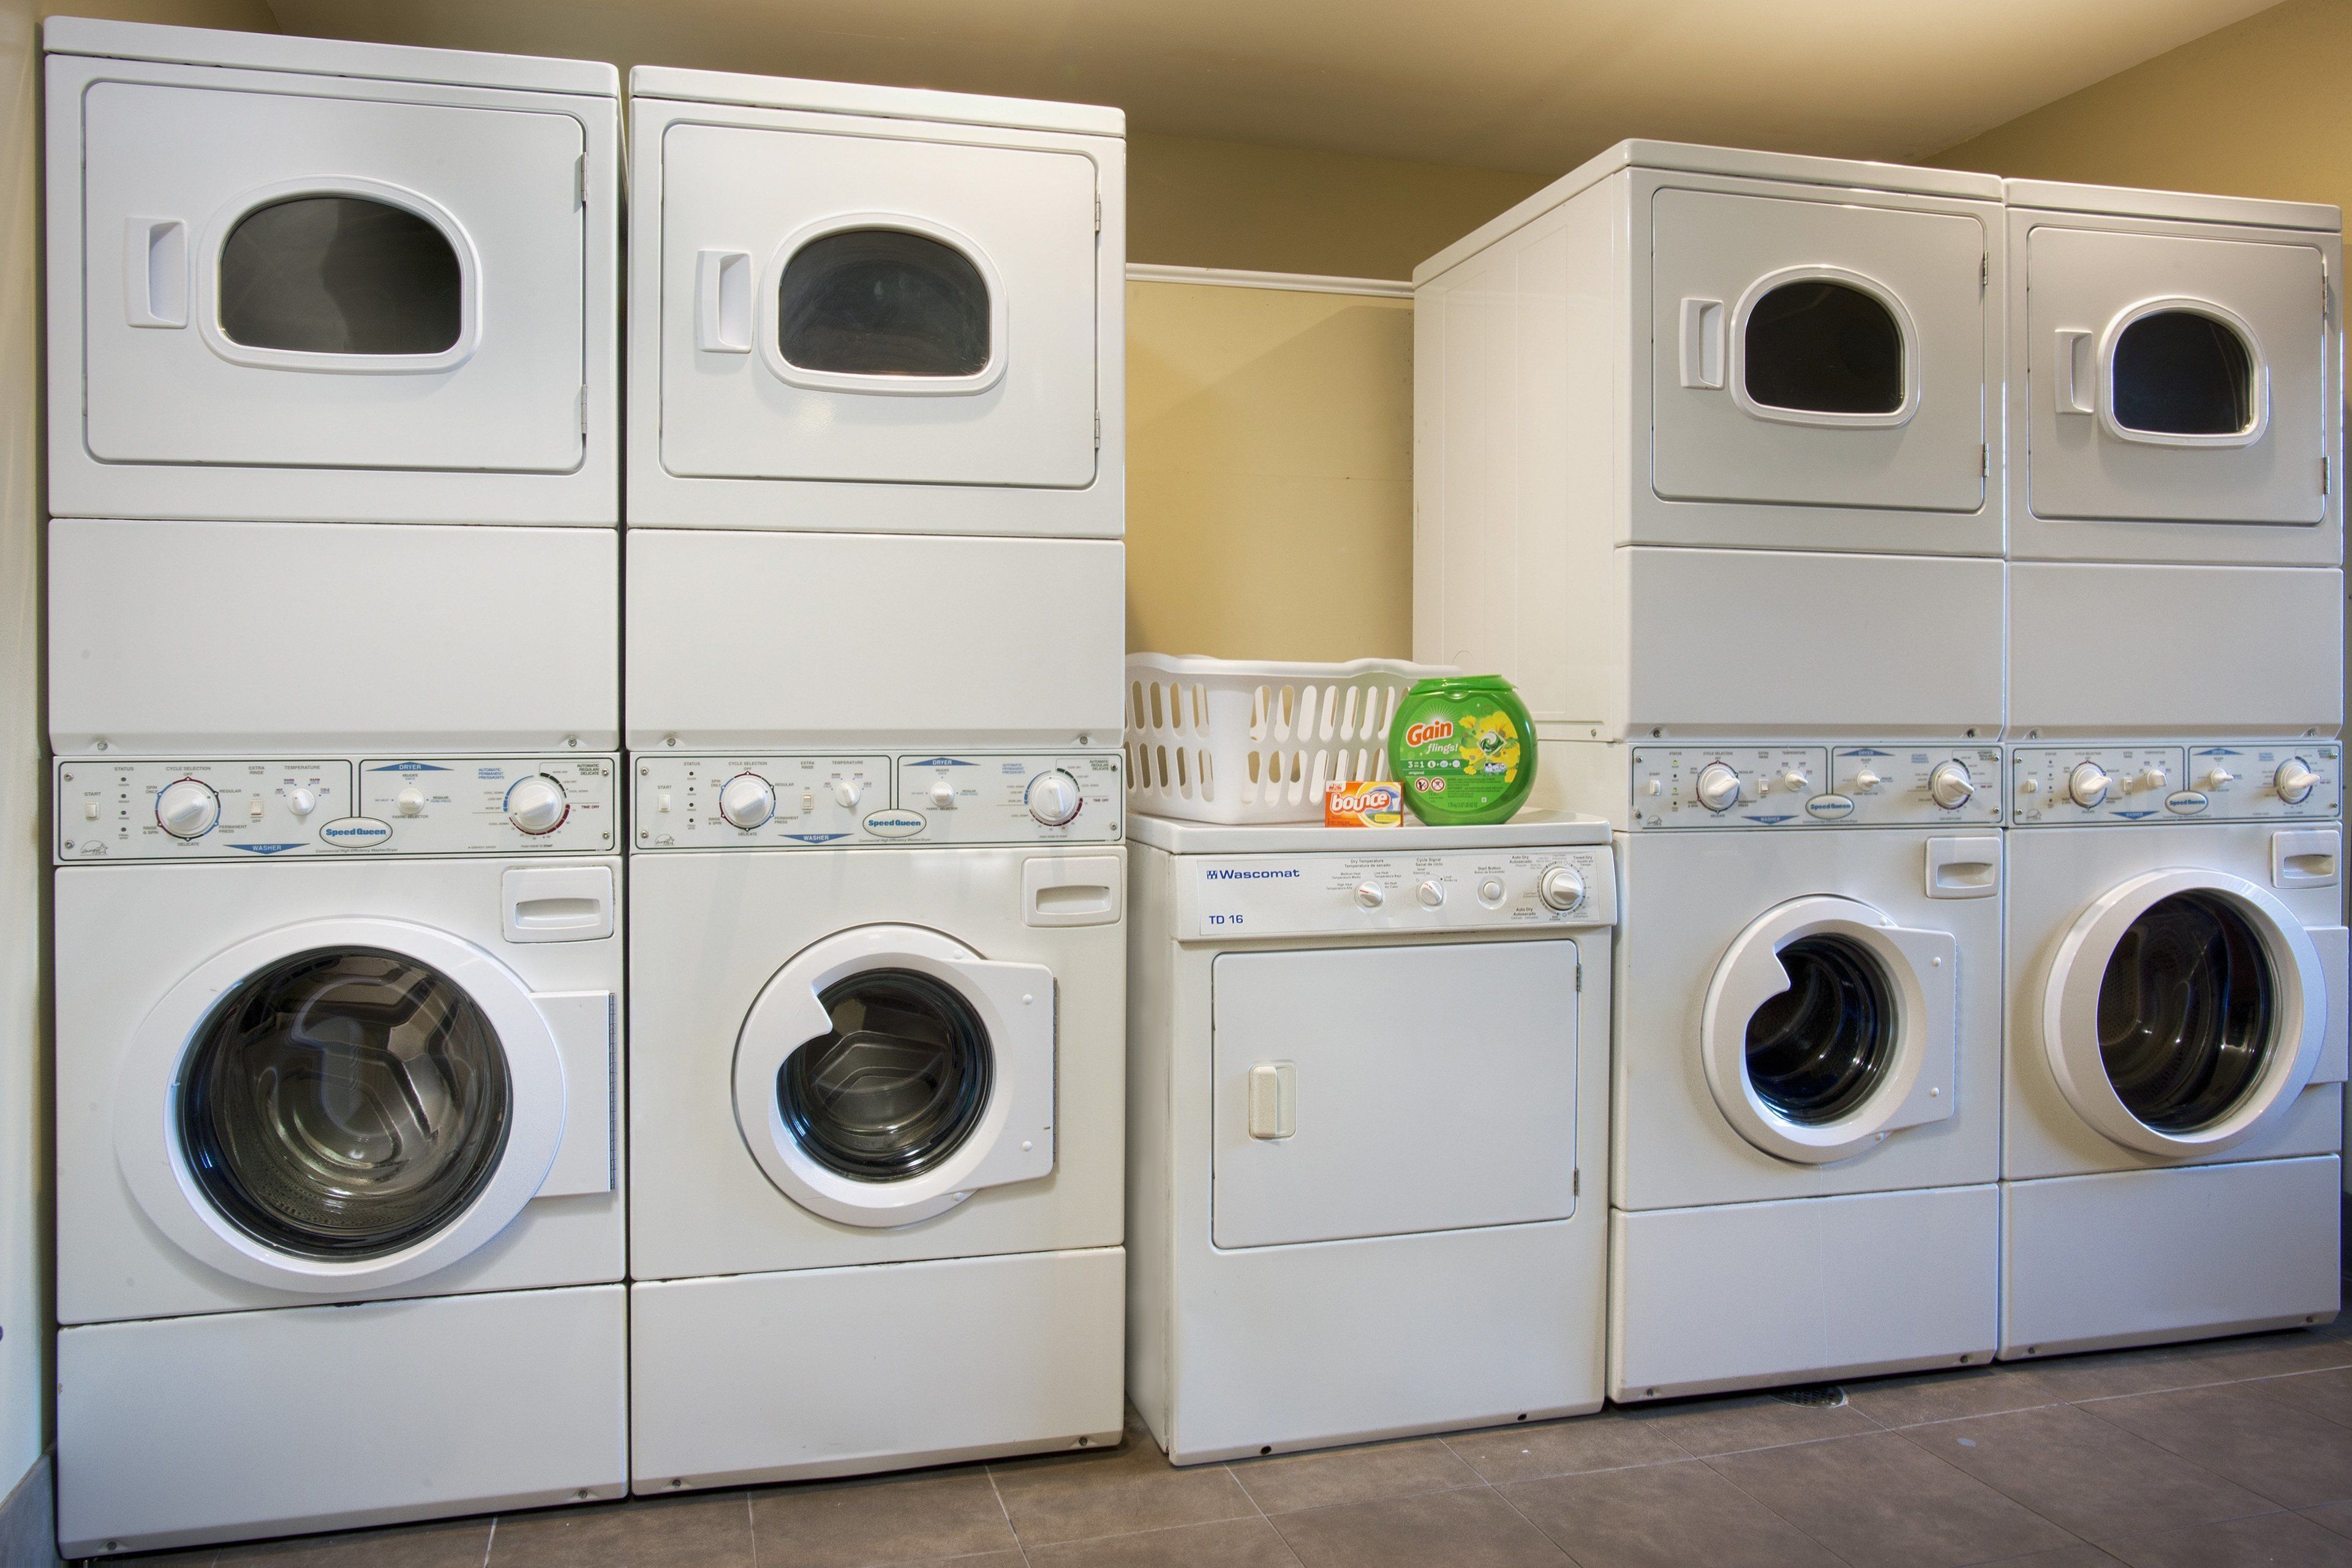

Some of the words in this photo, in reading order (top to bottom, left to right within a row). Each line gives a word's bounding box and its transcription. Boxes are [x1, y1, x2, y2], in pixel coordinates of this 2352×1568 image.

[1406, 720, 1453, 747] Gain
[1426, 743, 1458, 755] flings!
[1330, 792, 1391, 815] bounce
[326, 828, 356, 837] Speed
[1219, 869, 1300, 880] Wascomat
[1208, 916, 1225, 924] TD
[1229, 914, 1243, 924] 16
